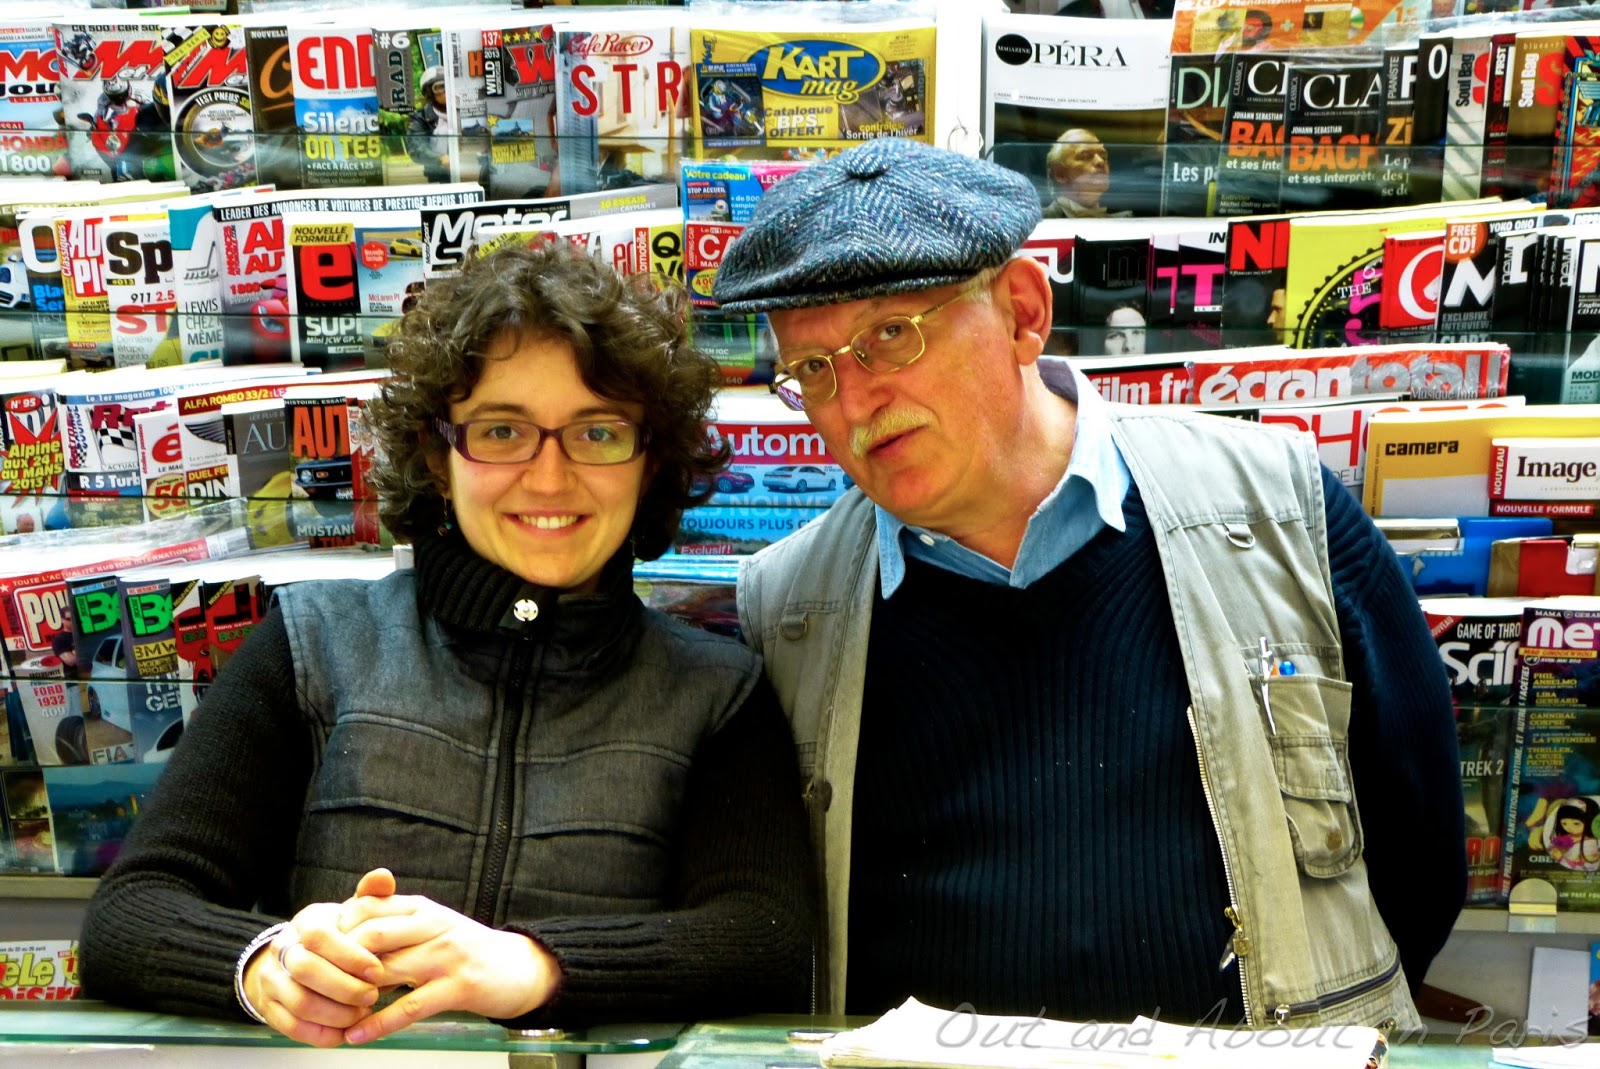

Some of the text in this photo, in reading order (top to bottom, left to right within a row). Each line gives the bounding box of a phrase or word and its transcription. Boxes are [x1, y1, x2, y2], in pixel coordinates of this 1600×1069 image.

[485, 61, 496, 95] WILD
[1233, 61, 1244, 97] CLASSICA
[1388, 56, 1399, 99] PIANISTE
[1456, 53, 1476, 107] Soul Bag
[1518, 53, 1539, 108] Soul Bag
[800, 78, 859, 104] mag
[1290, 76, 1298, 111] CLASSICA
[765, 105, 833, 117] Catalogue
[1233, 111, 1284, 121] JOHANN SEBASTIAN
[778, 114, 818, 129] BPS
[769, 125, 824, 137] OFFERT
[846, 129, 875, 139] Sortie
[1291, 126, 1343, 134] JOHANN SEBASTIAN
[360, 161, 374, 170] 125
[1226, 159, 1259, 170] et ses
[684, 168, 746, 181] Votre cadeau
[1173, 162, 1198, 182] Les
[1288, 174, 1321, 184] et ses
[220, 194, 456, 220] LEADER DES ANNONCES DE VOITURES DE PRESTIGE DEPUIS
[620, 203, 650, 212] CAYMAN
[294, 226, 347, 236] NOUVELLE
[1451, 224, 1478, 237] FREE
[1489, 218, 1535, 233] YOKO ONO
[295, 234, 344, 243] FORMULE
[1449, 236, 1476, 255] CD!
[58, 224, 71, 277] Classiques
[131, 290, 175, 304] 911 2.5
[1337, 282, 1372, 299] THE
[185, 298, 218, 315] LEWIS
[185, 316, 216, 331] CHEZ
[1442, 311, 1489, 322] EXCLUSIVE
[100, 390, 156, 402] 1er magazine
[1411, 387, 1456, 400] Musique
[23, 397, 36, 408] 95
[184, 392, 245, 411] ALFA ROMEO
[8, 440, 61, 460] Alpine
[1384, 440, 1459, 456] camera
[3, 453, 50, 470] aux 24
[1, 463, 63, 480] au MANS
[188, 470, 212, 482] DUEL
[1493, 447, 1505, 495] NOUVEAU
[1516, 455, 1597, 483] Image
[79, 475, 90, 489] R
[96, 475, 104, 487] 5
[1496, 505, 1591, 514] NOUVELLE FORMULE
[759, 518, 794, 530] PLUS
[13, 578, 40, 587] TOUTE
[1535, 610, 1562, 618] MAMA
[1457, 623, 1483, 639] GAME
[1484, 623, 1496, 639] OF
[13, 638, 24, 649] 25
[33, 684, 64, 697] FORD
[36, 695, 66, 708] 1932
[1460, 759, 1504, 777] TREK 2
